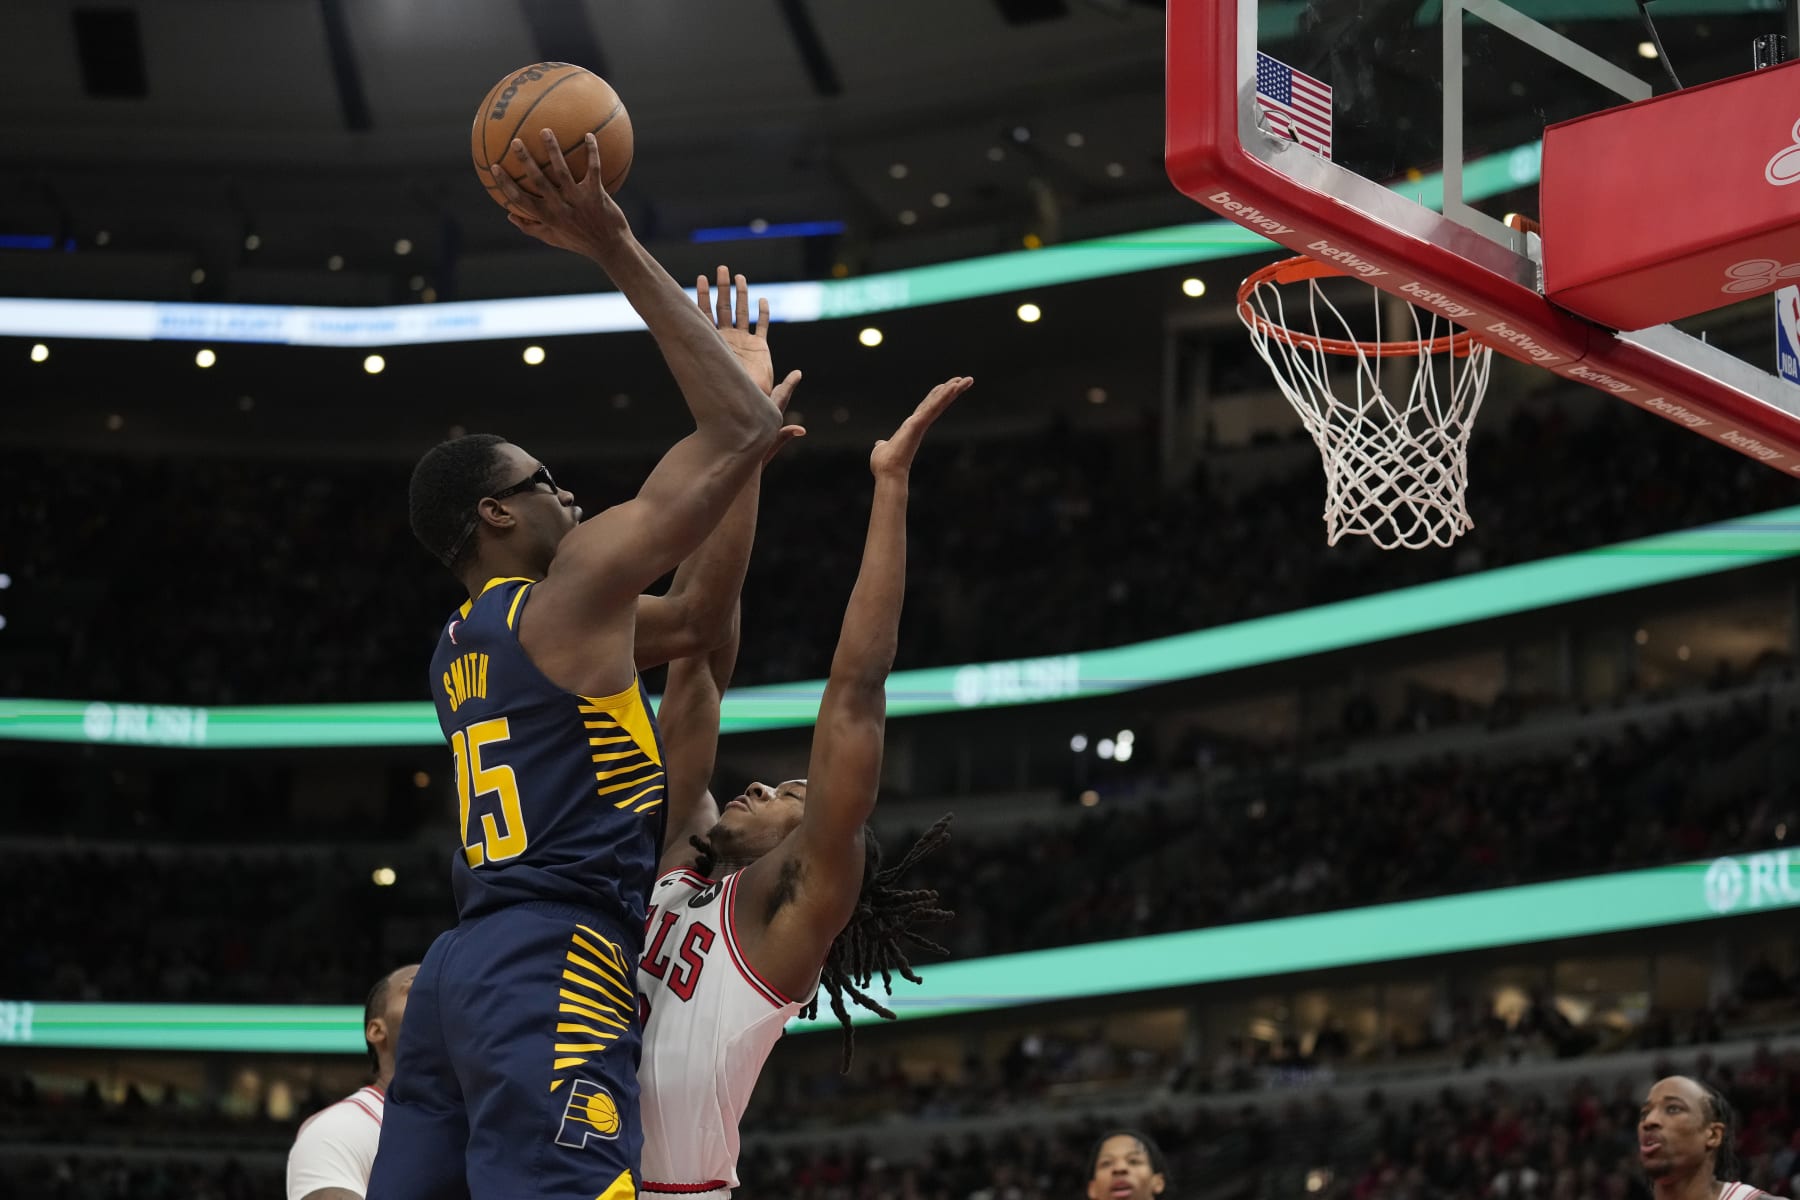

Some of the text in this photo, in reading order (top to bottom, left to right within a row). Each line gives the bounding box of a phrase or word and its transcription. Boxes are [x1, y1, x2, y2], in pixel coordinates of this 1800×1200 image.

[1208, 191, 1785, 460] betway betway betway betway betway betway betway
[1781, 351, 1798, 379] NBA
[443, 652, 489, 712] SMITH
